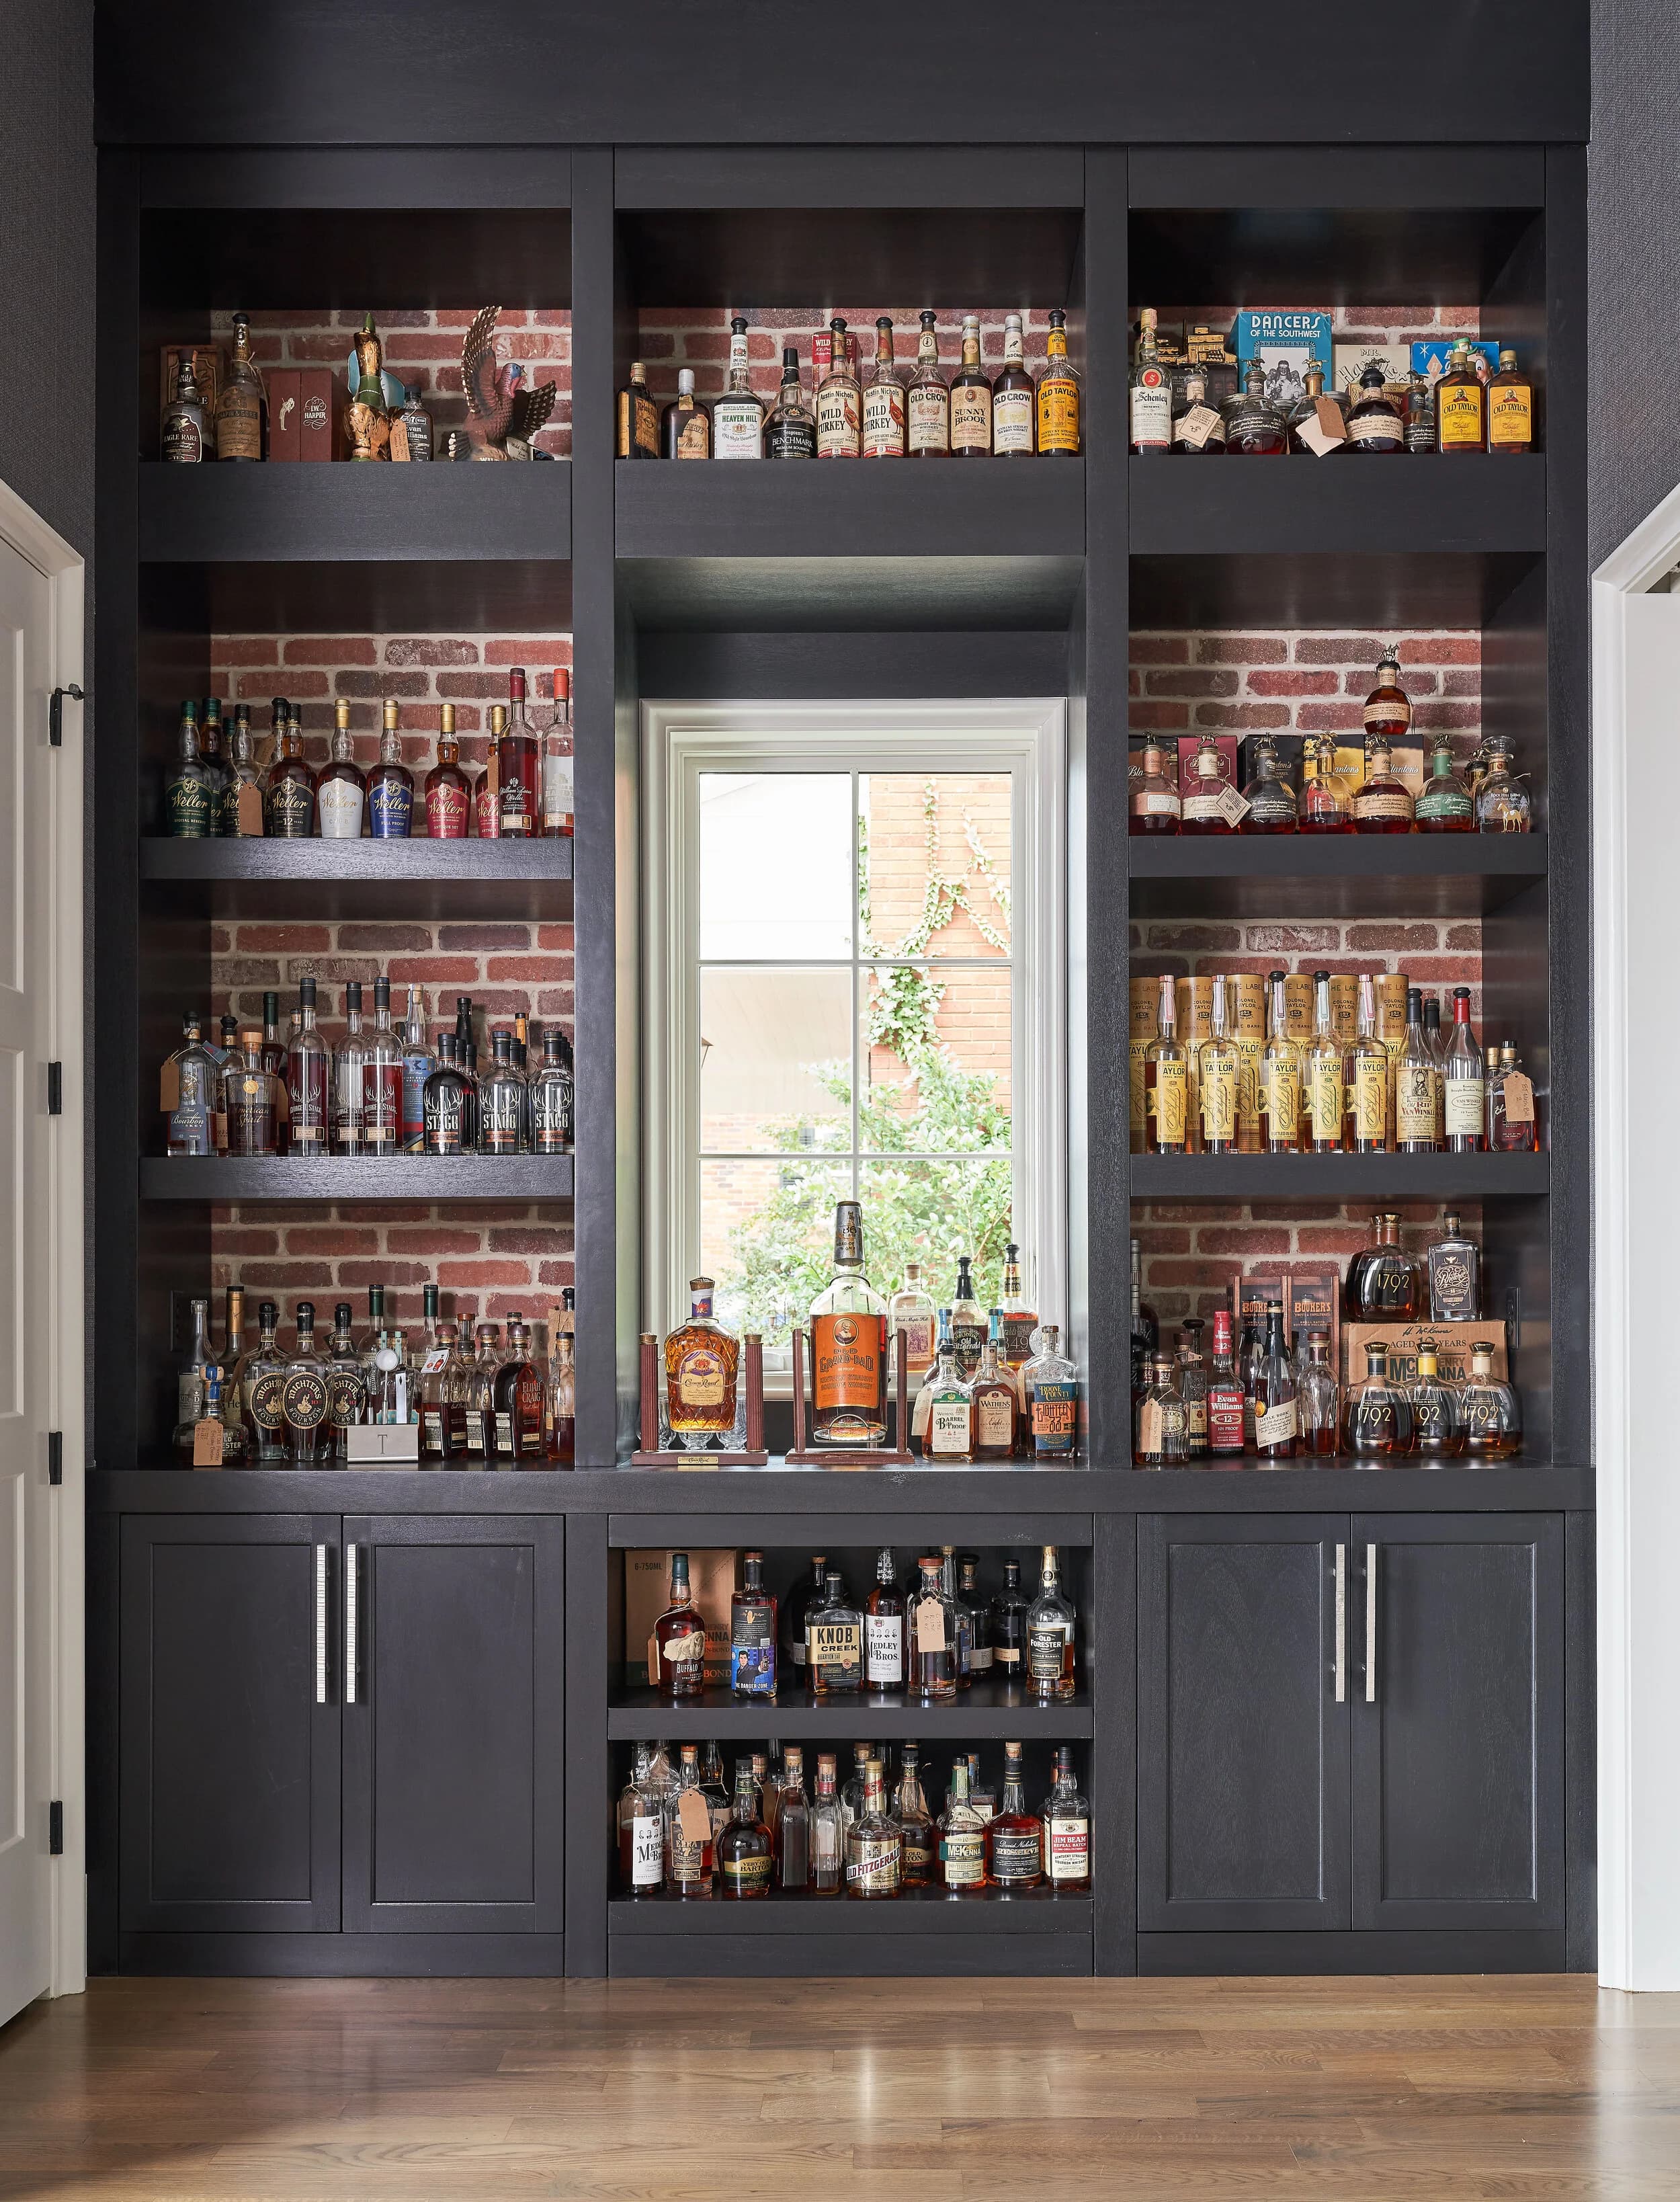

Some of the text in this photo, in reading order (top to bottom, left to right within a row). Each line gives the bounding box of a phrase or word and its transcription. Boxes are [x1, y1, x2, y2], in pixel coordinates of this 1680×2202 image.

[1251, 316, 1321, 329] DANCERS
[820, 391, 854, 401] Austin Nichols
[866, 388, 899, 398] Austin Nichols
[911, 393, 946, 403] OLD CROW
[1040, 388, 1077, 400] OLD TAYLOR
[1135, 391, 1167, 405] Schenley
[1383, 393, 1402, 404] BROOKS
[994, 393, 1031, 405] OLD CROW
[821, 408, 841, 419] WILD
[866, 405, 886, 417] WILD
[955, 408, 986, 416] SUNNY
[1443, 403, 1478, 413] OLD TAYLOR
[1493, 403, 1528, 413] OLD TAYLOR
[722, 415, 757, 423] HEAVEN HILL
[955, 415, 986, 426] BROOK
[818, 421, 845, 434] TURKEY
[864, 418, 891, 432] TURKEY
[772, 437, 813, 448] BENCHMARK
[1335, 765, 1359, 773] anton's
[1390, 765, 1419, 774] lanton's
[172, 790, 208, 808] Weller
[272, 791, 308, 808] Weller
[374, 794, 409, 810] Weller
[429, 797, 464, 815] Weller
[283, 817, 293, 825] 12
[1206, 1064, 1233, 1072] TAYLOR
[1270, 1064, 1297, 1072] TAYLOR
[1314, 1063, 1341, 1072] TAYLOR
[1358, 1063, 1384, 1071] TAYLOR
[1415, 1108, 1435, 1116] WINKLE
[171, 1112, 204, 1125] Bourbon
[427, 1115, 458, 1130] STAGG
[483, 1114, 516, 1129] STAGG
[536, 1112, 569, 1128] STAGG
[842, 1225, 857, 1234] 86
[1378, 1273, 1410, 1294] 1792
[1294, 1301, 1331, 1313] BOOKER'S
[1390, 1340, 1415, 1348] AGED
[1438, 1339, 1466, 1347] YEARS
[819, 1355, 874, 1373] GRAND-DAD
[522, 1381, 541, 1392] ELIJAH
[685, 1378, 720, 1388] Crown Royal
[288, 1379, 322, 1400] MICHTER'S
[1040, 1385, 1062, 1396] BOONE
[522, 1392, 540, 1402] CRAIG
[1044, 1390, 1070, 1401] COUNTY
[980, 1399, 1011, 1408] WATHEN'S
[289, 1408, 323, 1423] BOURBON
[1037, 1402, 1072, 1422] EIGHTEEN
[1357, 1407, 1392, 1427] 1792
[1464, 1405, 1499, 1426] 1792
[935, 1416, 964, 1430] BARREL
[1049, 1416, 1062, 1432] 33
[1224, 1415, 1232, 1423] 12
[1259, 1414, 1275, 1423] LITTLE
[378, 1434, 388, 1455] T
[634, 1562, 663, 1570] 6-750ML
[817, 1627, 853, 1644] KNOB
[874, 1650, 899, 1660] BROS.
[677, 1663, 698, 1674] BUFFALO
[704, 1669, 731, 1678] BOND
[1016, 1839, 1038, 1848] Nicholson
[681, 1848, 690, 1857] 7
[857, 1847, 900, 1875] FITZGERALD
[741, 1864, 769, 1873] BARTON
